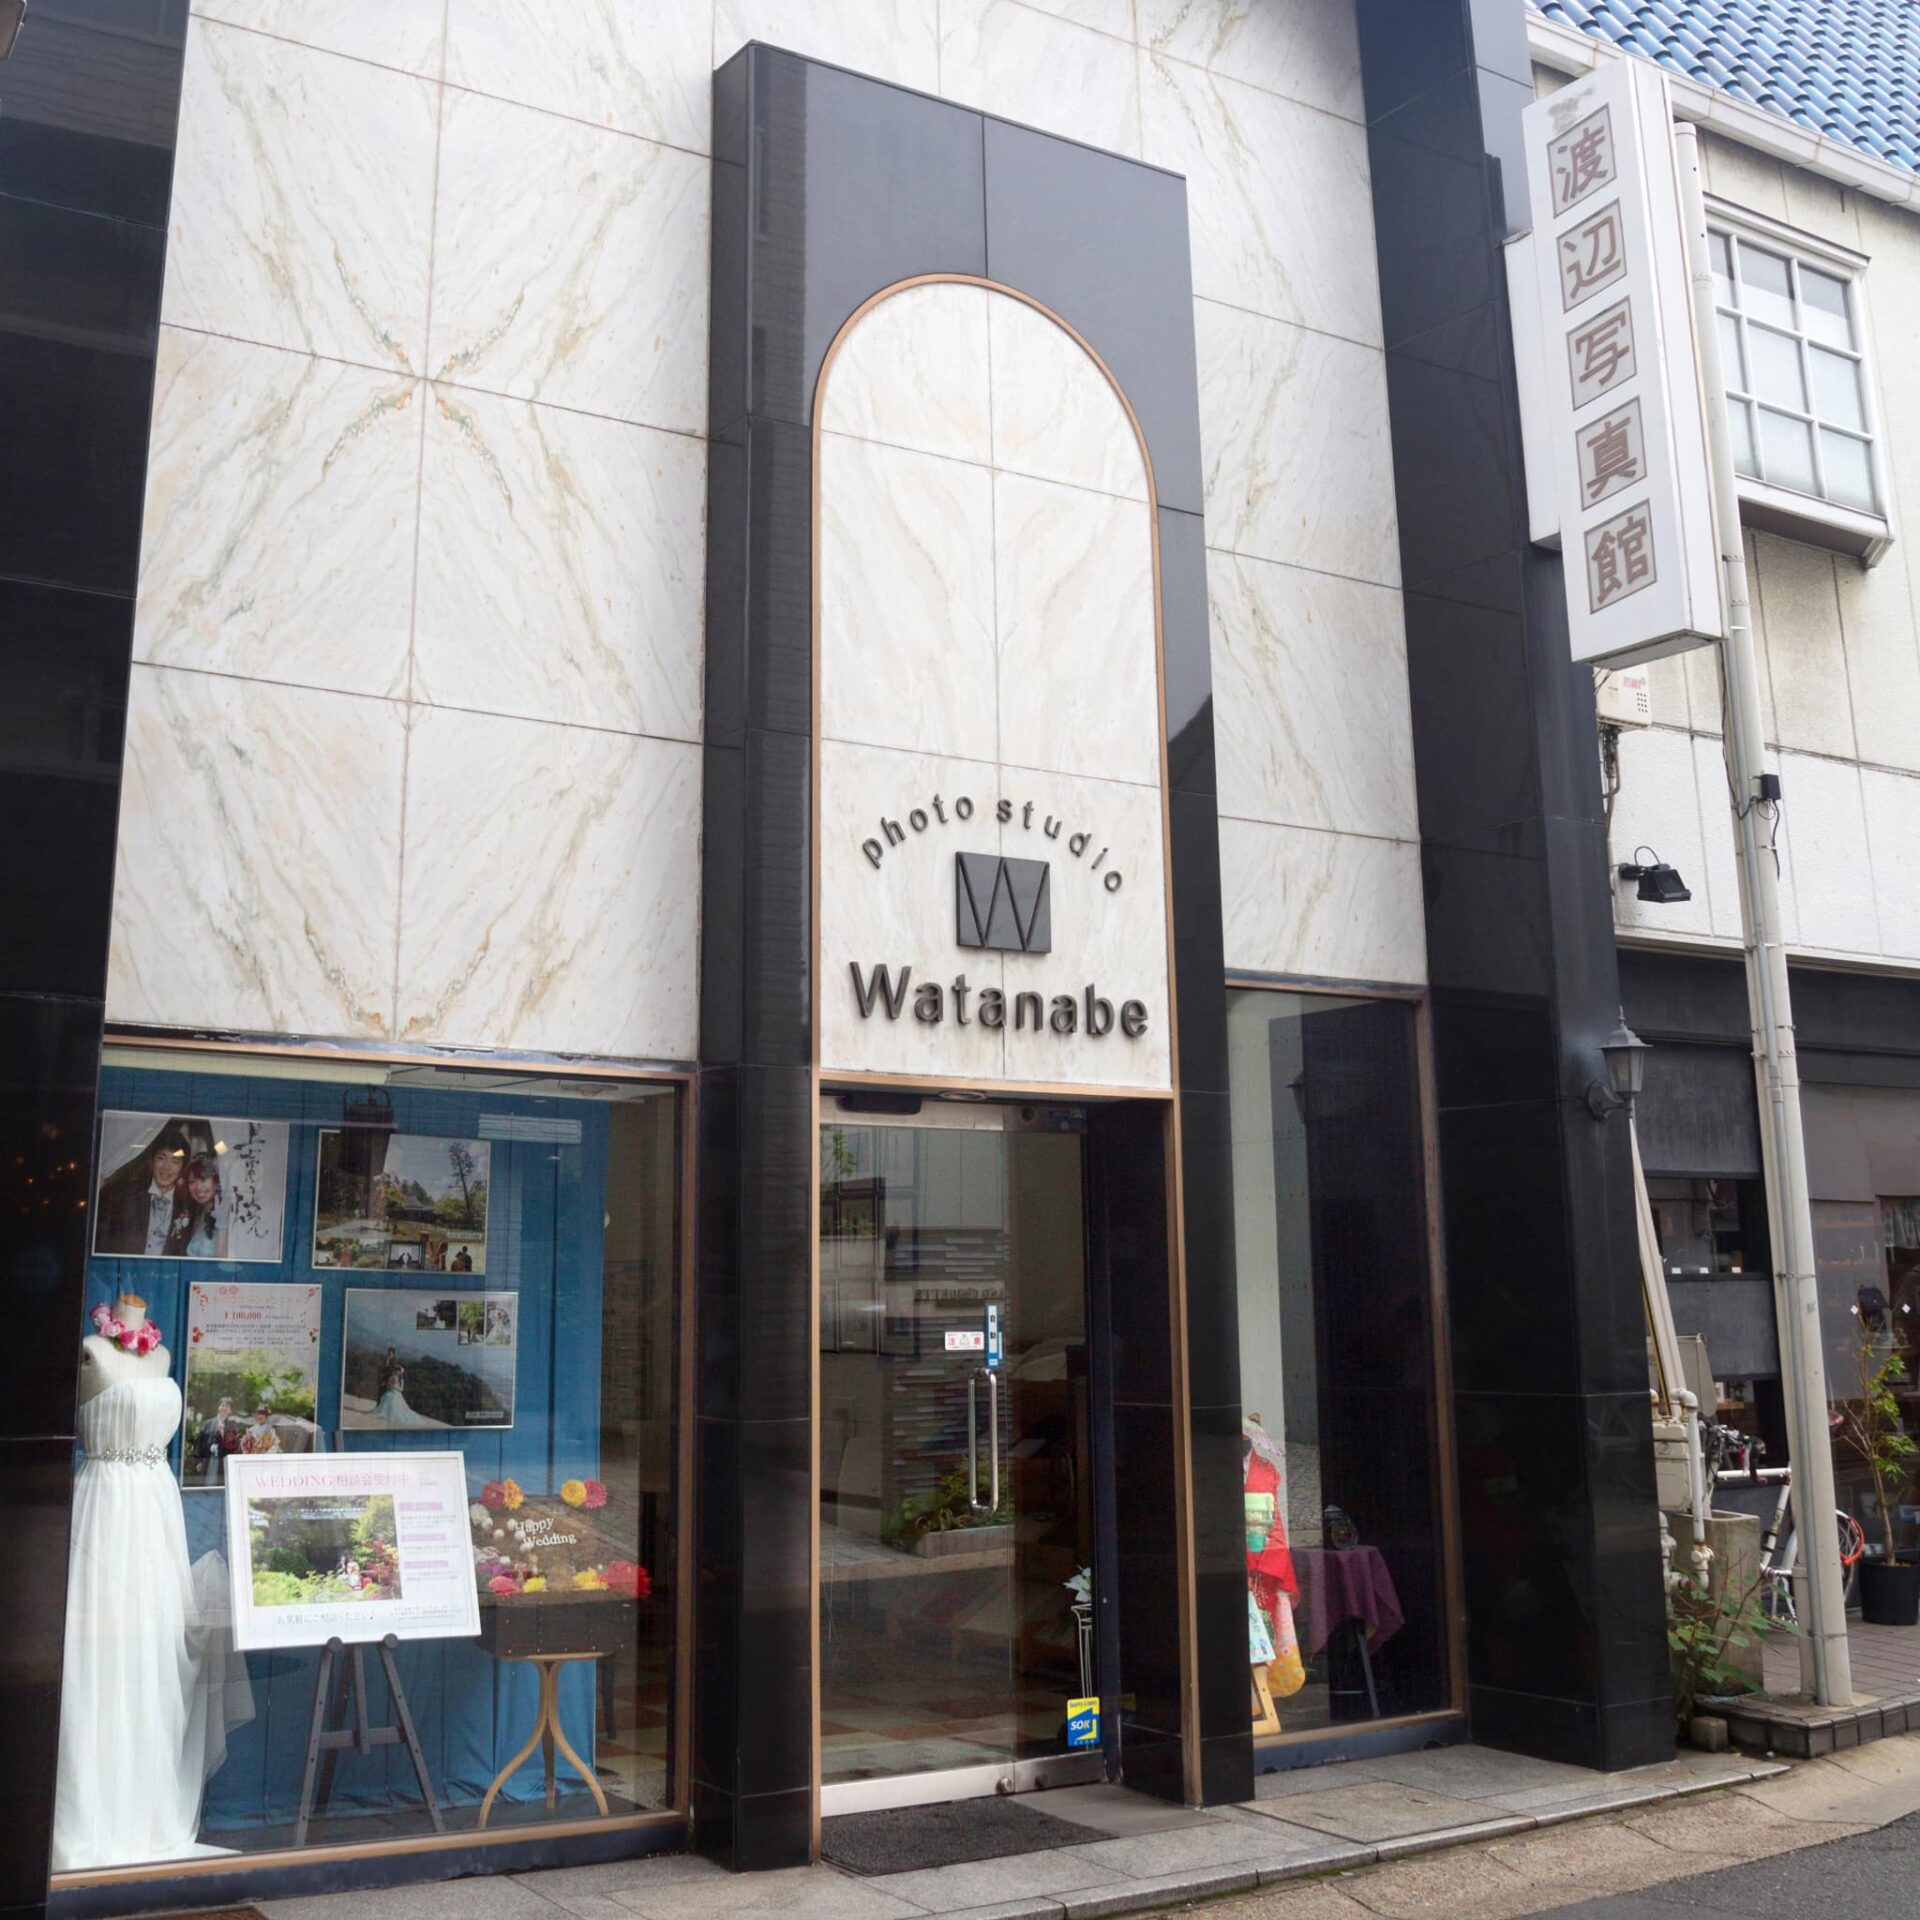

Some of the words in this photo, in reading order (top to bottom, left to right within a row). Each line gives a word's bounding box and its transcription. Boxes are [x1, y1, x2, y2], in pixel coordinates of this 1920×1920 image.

[1556, 126, 1650, 606] 渡辺写真館
[862, 793, 974, 869] photo
[996, 798, 1123, 893] studio
[849, 961, 1148, 1039] Watanabe
[255, 1475, 333, 1488] WEDDING
[515, 1517, 554, 1534] Happy
[523, 1533, 577, 1547] Wedding
[1070, 1719, 1091, 1731] SOK
